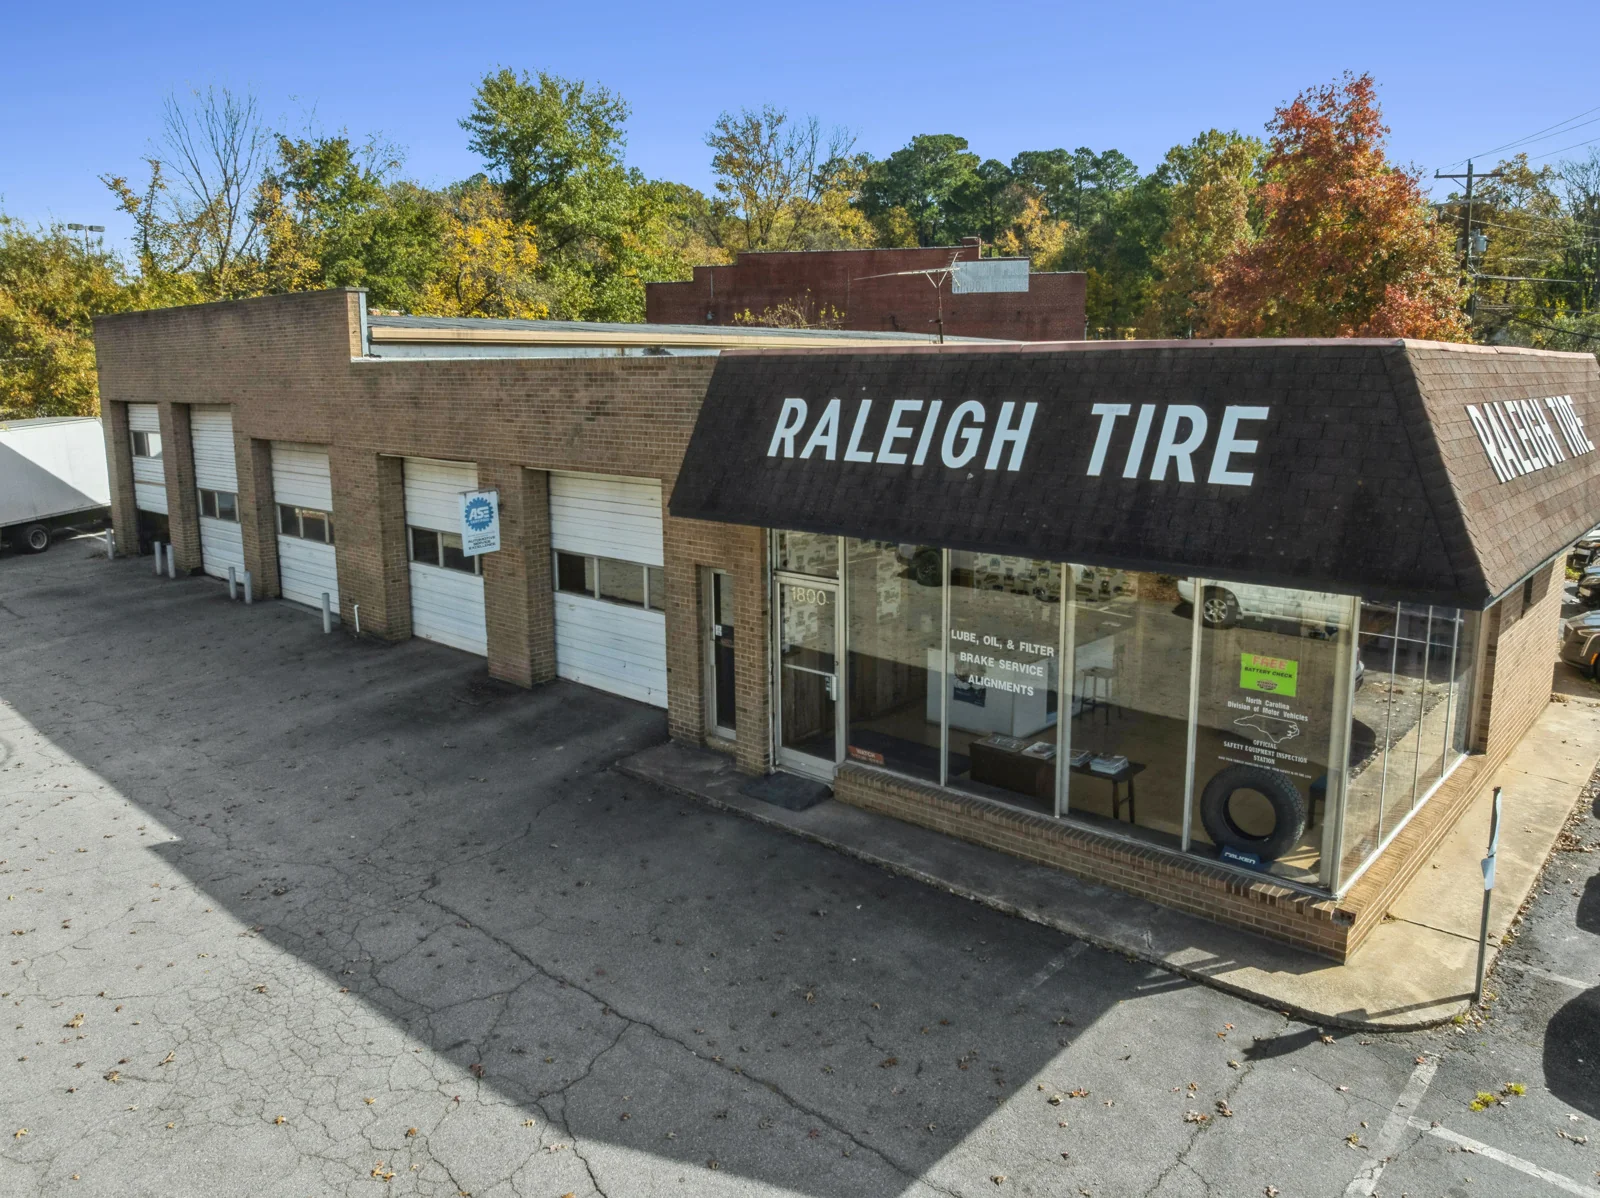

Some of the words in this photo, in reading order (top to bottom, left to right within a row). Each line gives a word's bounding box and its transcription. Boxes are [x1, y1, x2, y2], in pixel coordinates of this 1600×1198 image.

[767, 397, 1038, 472] RALEIGH
[1086, 403, 1270, 486] TIRE
[1465, 398, 1565, 483] RALEIGH
[1544, 395, 1595, 458] TIRE
[469, 506, 490, 520] ASE
[791, 586, 826, 605] 1800
[951, 629, 979, 645] LUBE,
[983, 636, 1003, 650] OIL,
[1006, 640, 1015, 650] &
[1020, 642, 1054, 657] FILTER
[960, 652, 994, 667] BRAKE
[999, 660, 1044, 676] SERVICE
[1252, 655, 1287, 670] FREE
[1244, 666, 1271, 675] BATTERY
[1272, 671, 1293, 679] CHECK
[968, 675, 1034, 696] ALIGNMENTS
[1227, 701, 1250, 710] Division
[1262, 707, 1280, 716] Motor
[1283, 711, 1308, 721] Vehicles
[1246, 696, 1262, 705] North
[1265, 699, 1290, 710] Carolina
[1223, 740, 1243, 750] SAFETY
[1245, 745, 1275, 757] EQUIPMENT
[1276, 751, 1308, 764] INSPECTION
[1253, 739, 1277, 750] OFFICIAL
[1253, 755, 1275, 765] STATION
[1224, 852, 1256, 864] FALKEN
